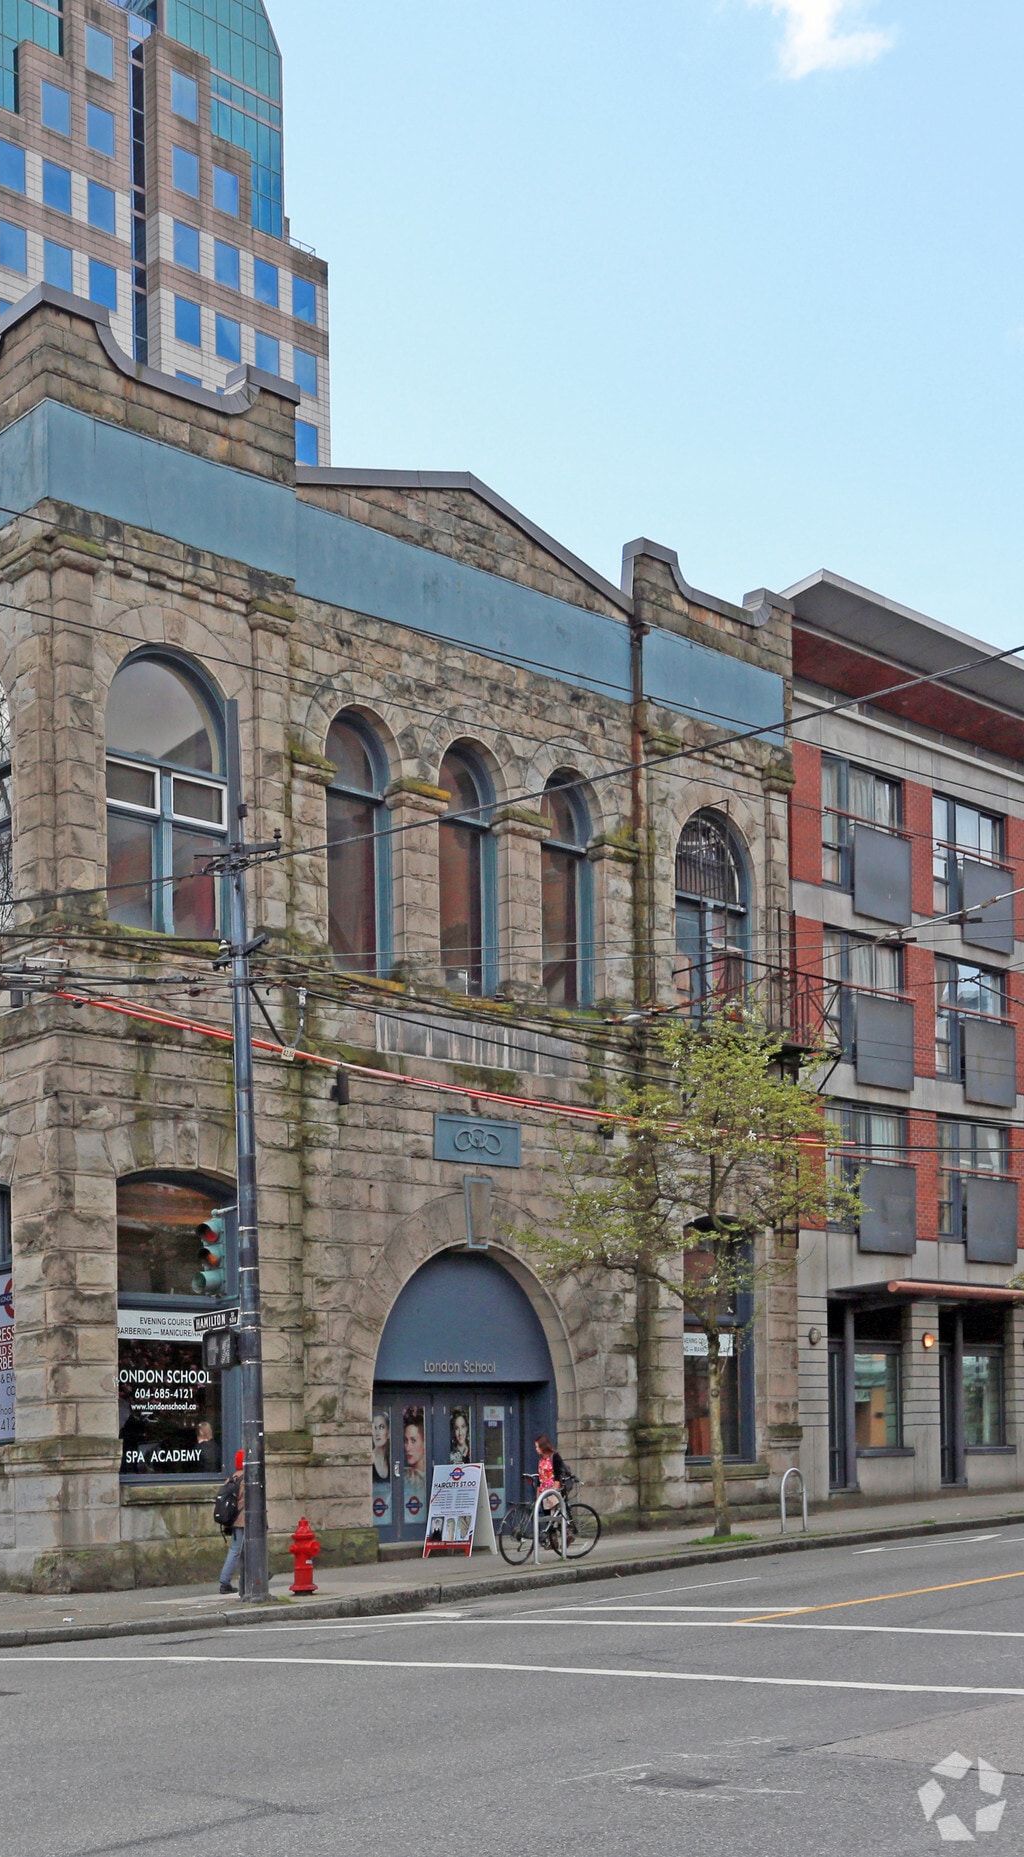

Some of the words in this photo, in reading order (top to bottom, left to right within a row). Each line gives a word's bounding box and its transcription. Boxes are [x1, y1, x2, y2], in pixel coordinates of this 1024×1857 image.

[139, 1316, 166, 1326] EVENING
[196, 1313, 226, 1330] HAMILTON
[424, 1360, 460, 1373] London
[464, 1360, 496, 1373] School
[117, 1369, 163, 1384] ONDON
[166, 1369, 212, 1384] SCHOOL
[134, 1388, 194, 1399] 604-685-4121
[130, 1401, 197, 1411] www.londonschool.ca
[125, 1450, 145, 1463] SPA
[150, 1449, 202, 1463] ACADEMY
[433, 1481, 460, 1489] HAIRCUTS
